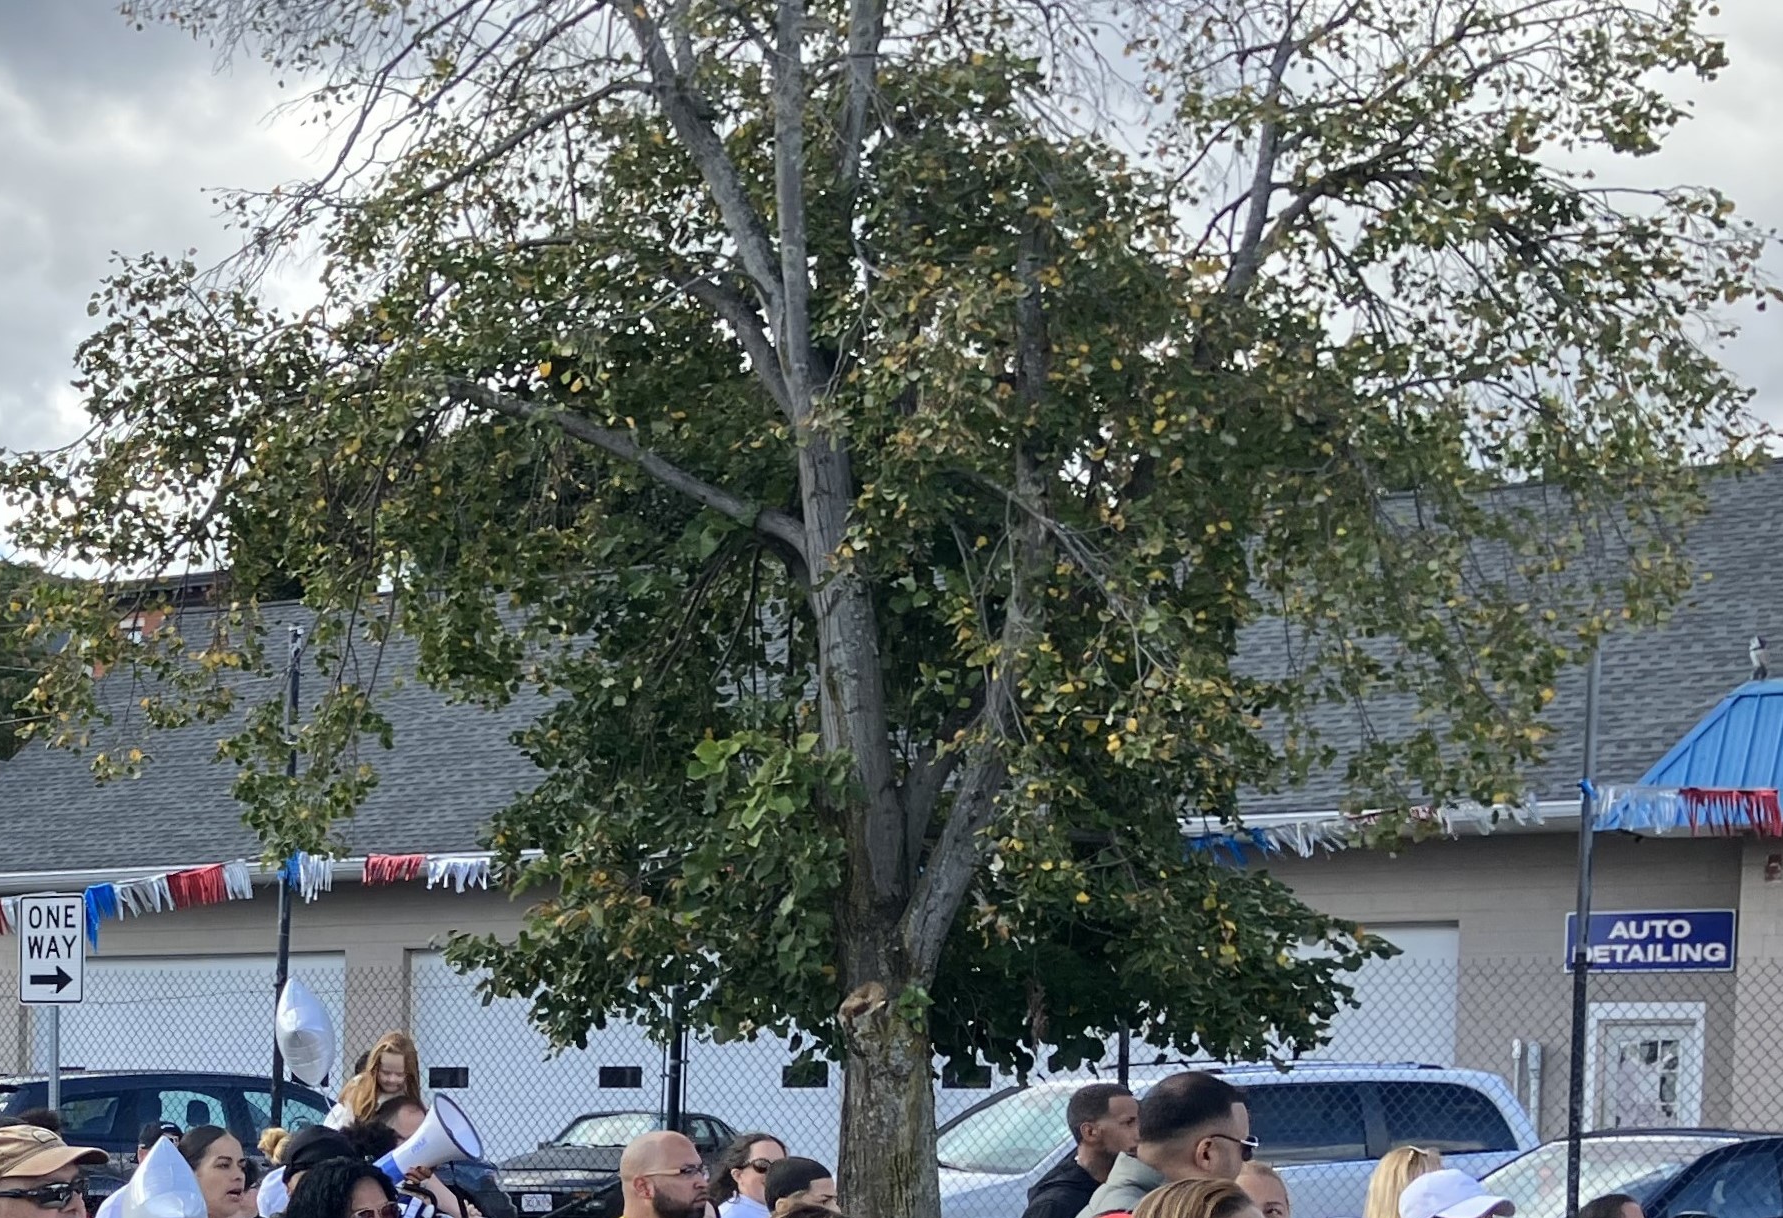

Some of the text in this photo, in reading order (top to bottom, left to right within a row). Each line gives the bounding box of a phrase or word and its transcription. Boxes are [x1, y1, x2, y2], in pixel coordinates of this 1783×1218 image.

[29, 905, 76, 929] ONE
[1607, 919, 1691, 940] AUTO
[28, 935, 77, 959] WAY
